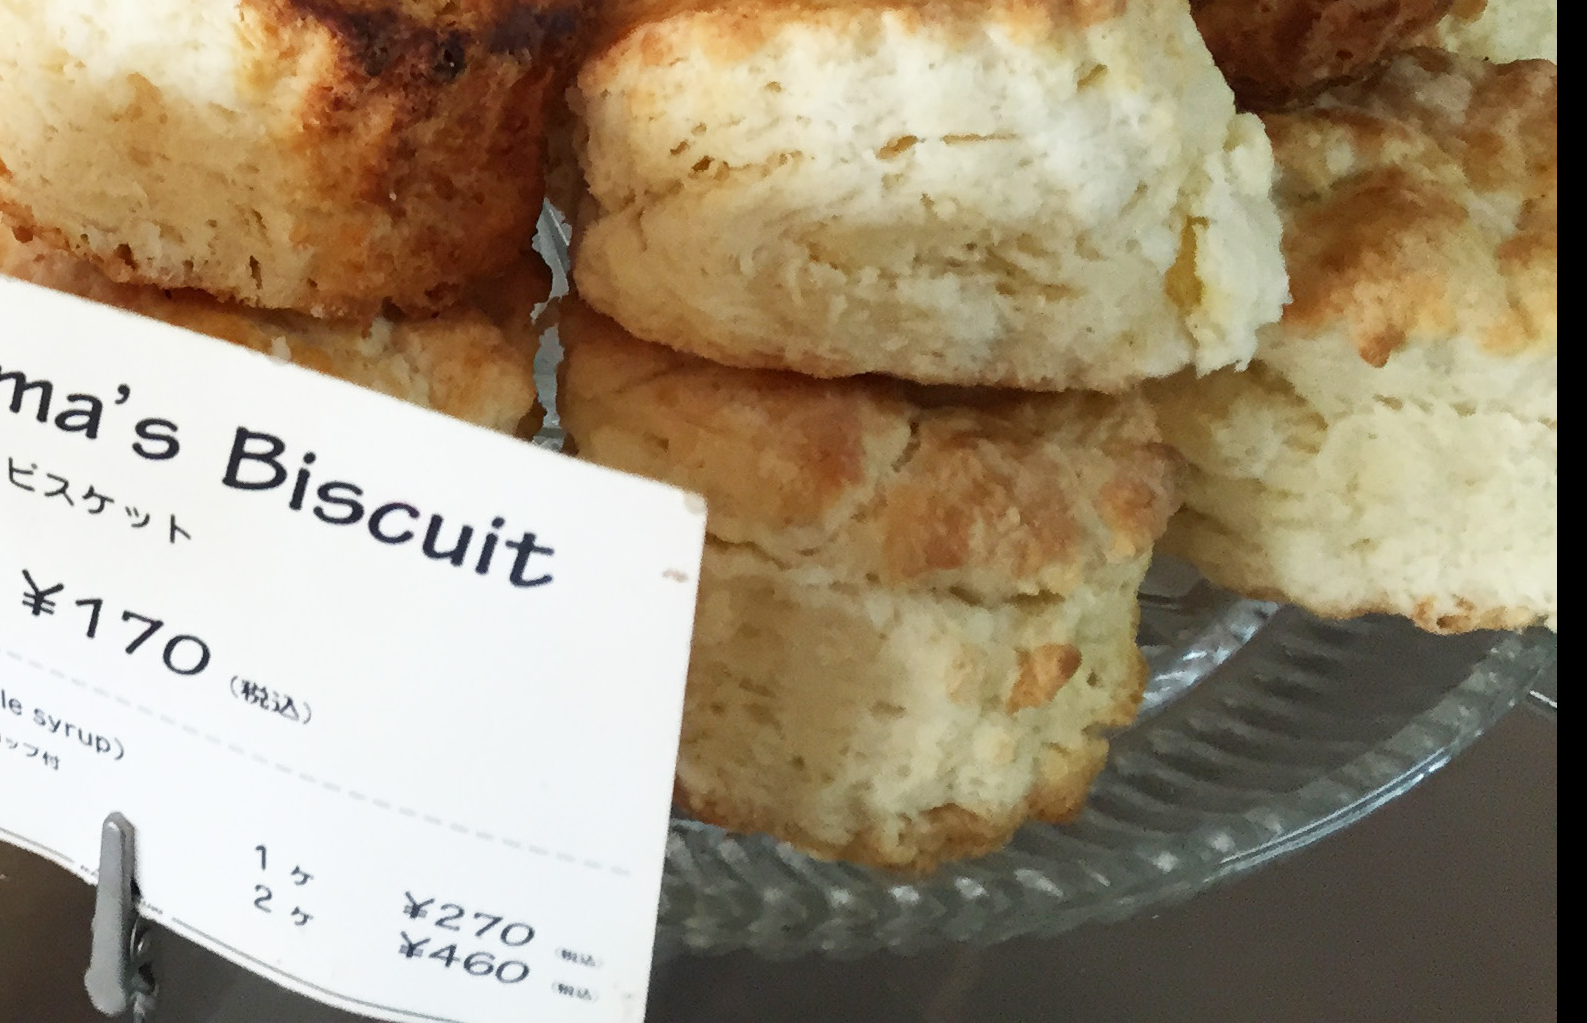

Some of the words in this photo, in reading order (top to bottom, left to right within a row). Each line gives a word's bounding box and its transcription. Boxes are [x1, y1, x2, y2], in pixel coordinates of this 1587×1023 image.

[8, 457, 192, 544] ビスケット
[221, 426, 555, 588] Biscuit
[21, 569, 211, 675] ¥170
[33, 708, 124, 760] syrup)
[403, 891, 535, 947] ¥270
[399, 931, 530, 984] ¥460
